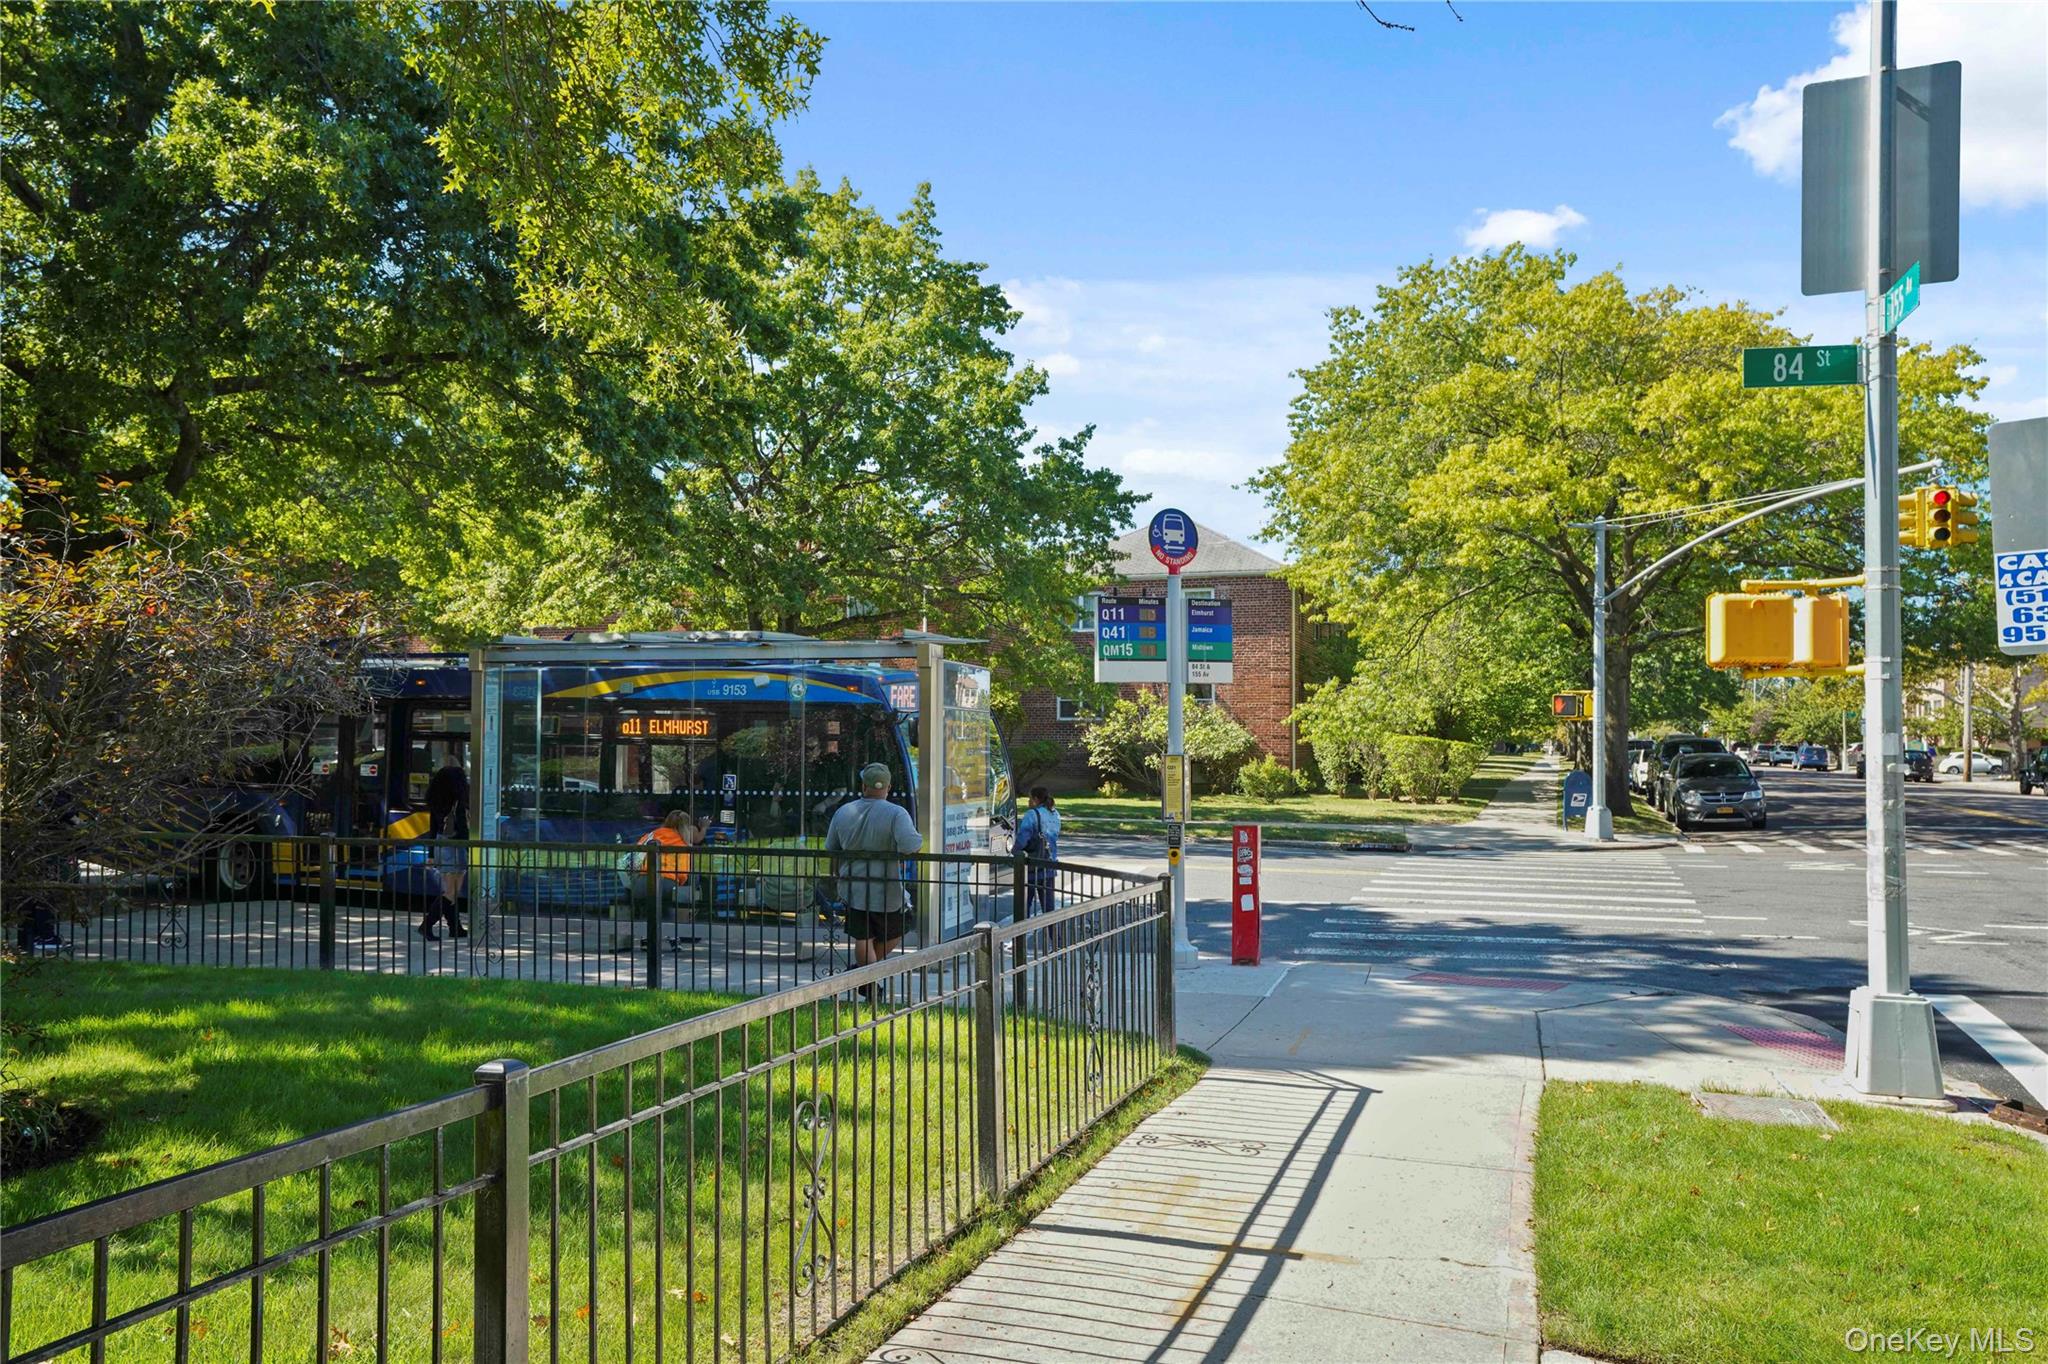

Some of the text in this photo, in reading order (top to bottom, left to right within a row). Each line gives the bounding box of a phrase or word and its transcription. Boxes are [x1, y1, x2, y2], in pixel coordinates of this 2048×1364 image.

[1773, 349, 1831, 382] 84 St
[1155, 550, 1194, 565] NO STANDING
[1999, 554, 2048, 571] CA
[1102, 608, 1125, 621] Q11
[1102, 626, 1126, 639] Q41
[2002, 625, 2046, 643] 95
[1103, 643, 1134, 656] QM15
[722, 684, 747, 696] 9153
[890, 684, 916, 708] FARE
[650, 719, 709, 735] ELMHURST
